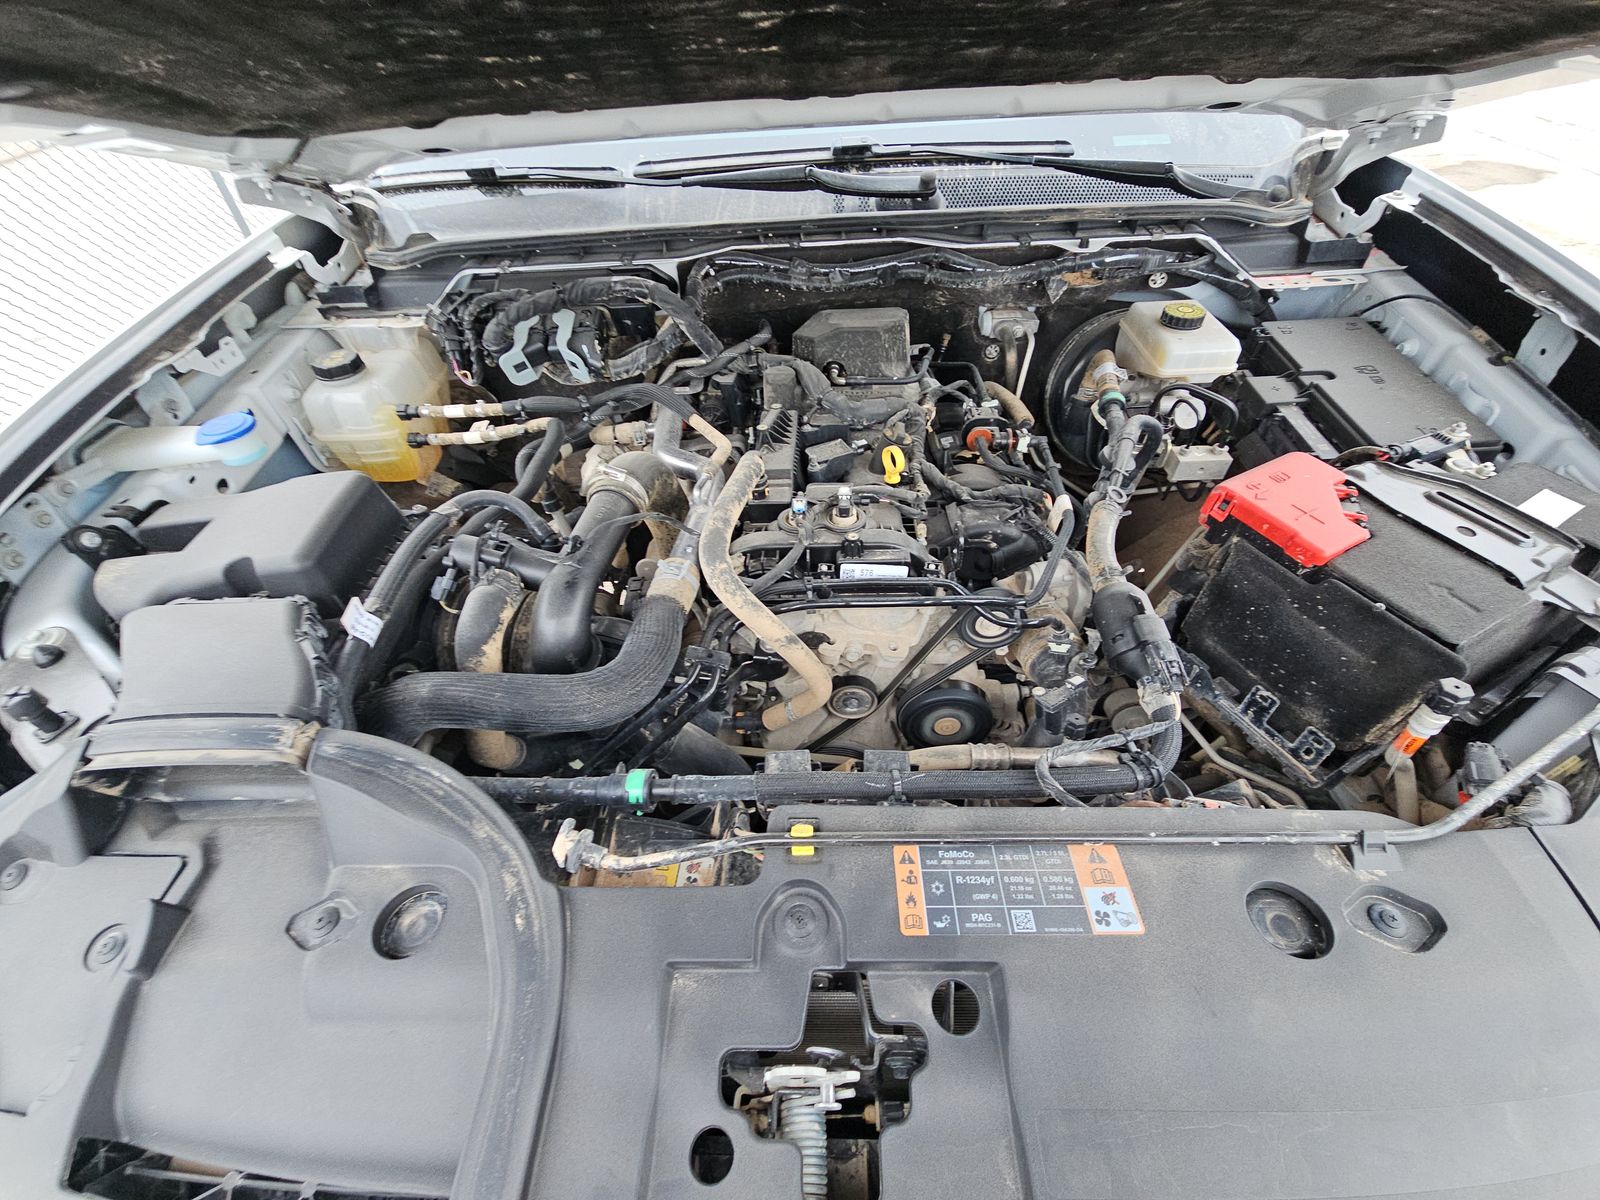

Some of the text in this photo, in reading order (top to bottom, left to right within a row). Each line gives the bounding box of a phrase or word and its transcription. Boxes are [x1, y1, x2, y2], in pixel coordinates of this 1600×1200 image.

[938, 850, 975, 858] FoMoCo
[956, 875, 995, 886] R-1234yf
[1025, 876, 1035, 885] kg
[1064, 876, 1074, 885] kg
[971, 913, 993, 922] PAG
